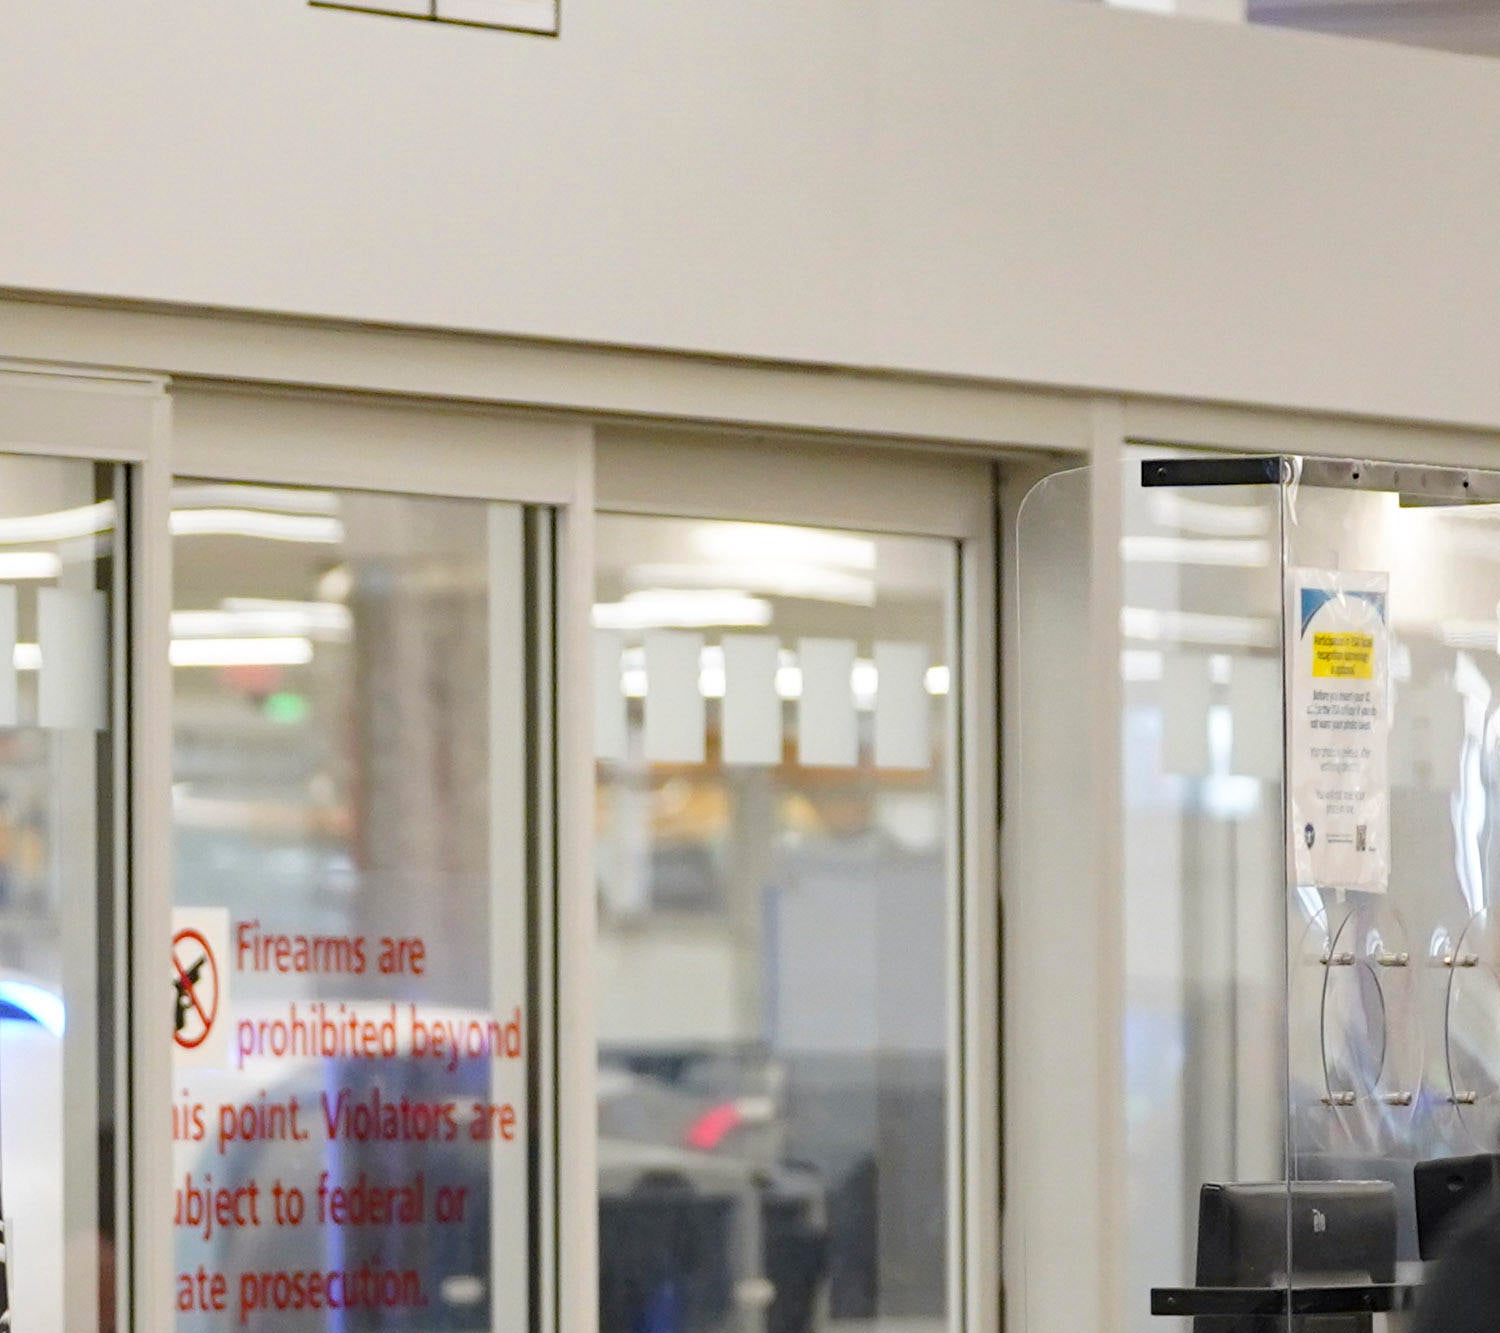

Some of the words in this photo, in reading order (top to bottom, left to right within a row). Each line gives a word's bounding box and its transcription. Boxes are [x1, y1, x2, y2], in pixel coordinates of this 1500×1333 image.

[236, 922, 367, 974] Firearms
[379, 938, 426, 975] are
[238, 1002, 398, 1068] prohibited
[409, 1008, 522, 1070] beyond
[219, 1096, 309, 1151] point.
[324, 1088, 456, 1141] Violators
[469, 1100, 516, 1140] are
[272, 1180, 305, 1225] to
[318, 1174, 424, 1225] federal
[434, 1188, 468, 1224] or
[240, 1258, 429, 1321] prosecution.
